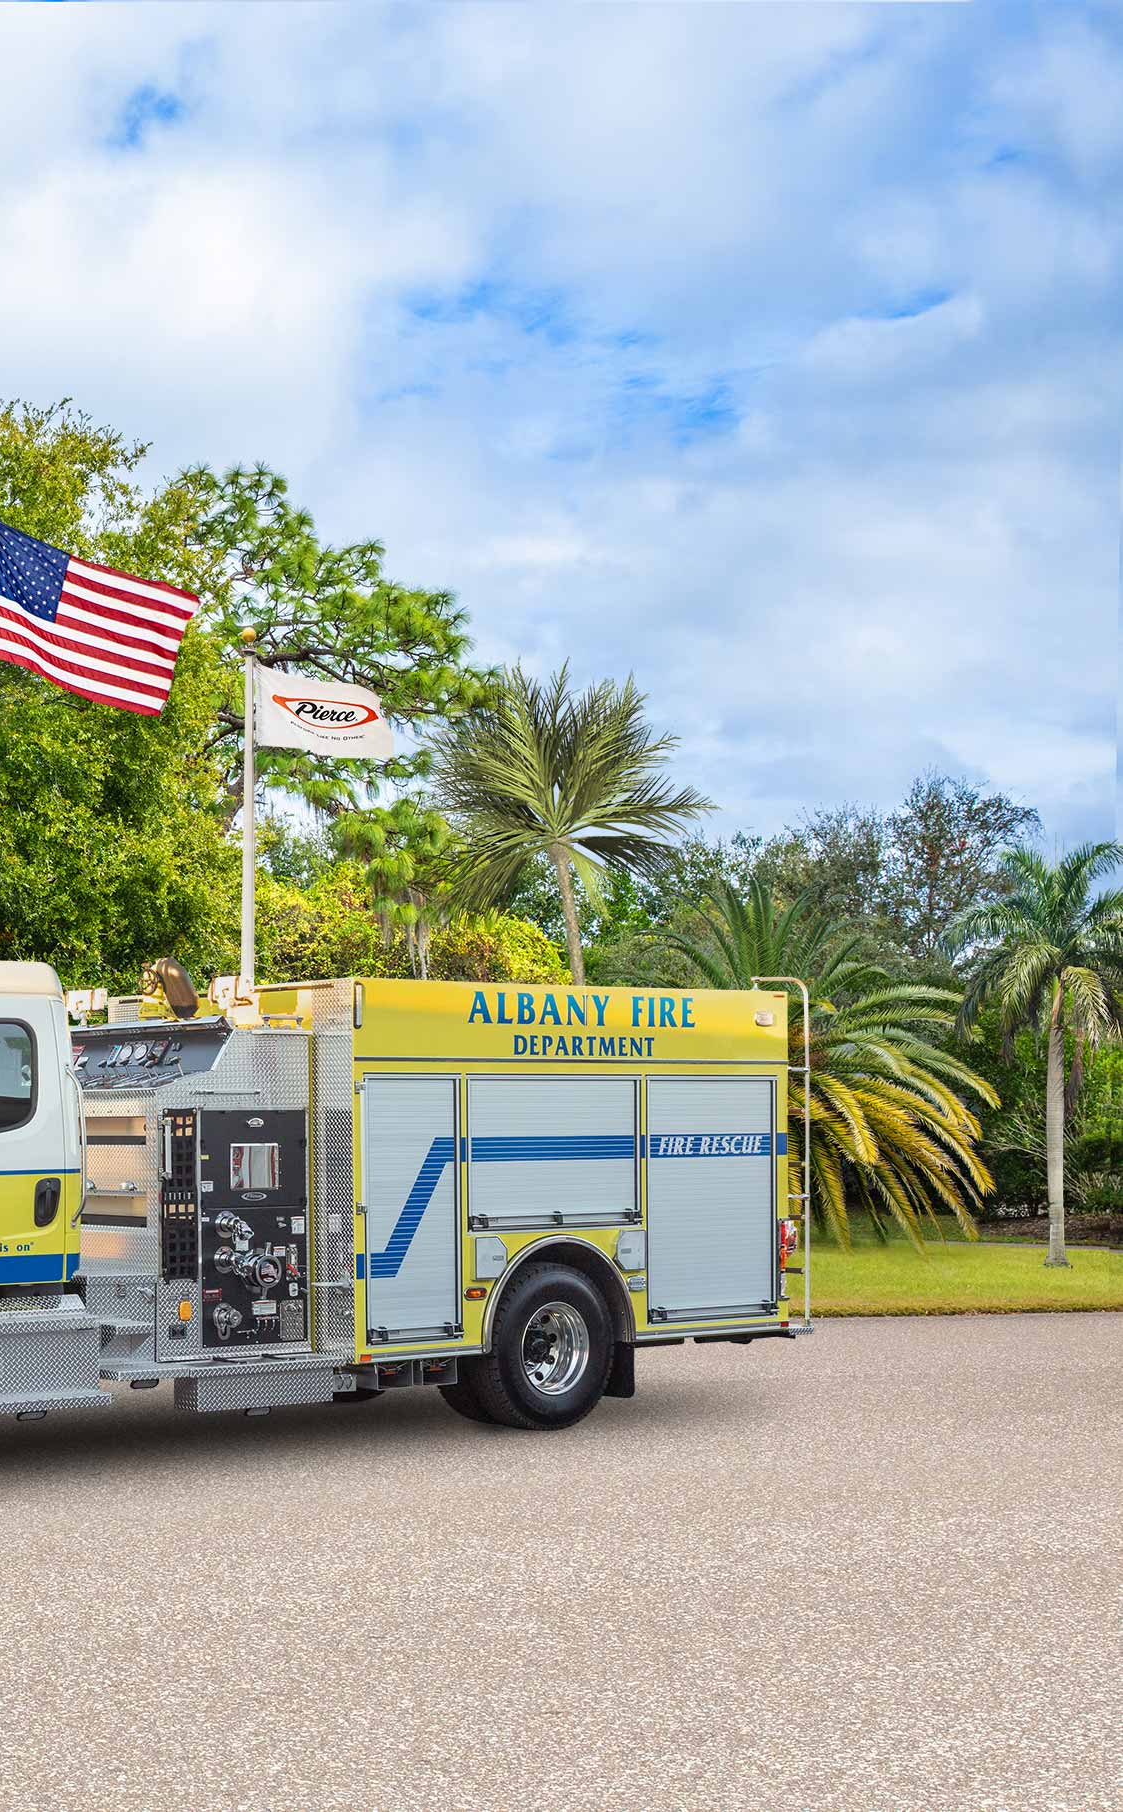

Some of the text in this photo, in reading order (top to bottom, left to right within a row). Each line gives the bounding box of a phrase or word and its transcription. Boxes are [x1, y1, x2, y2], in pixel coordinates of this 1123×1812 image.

[295, 701, 356, 722] Pierce
[467, 991, 696, 1028] ALBANY FIRE
[513, 1034, 655, 1057] DEPARTMENT
[658, 1135, 763, 1155] FIRE RESCUE
[0, 1242, 9, 1252] is
